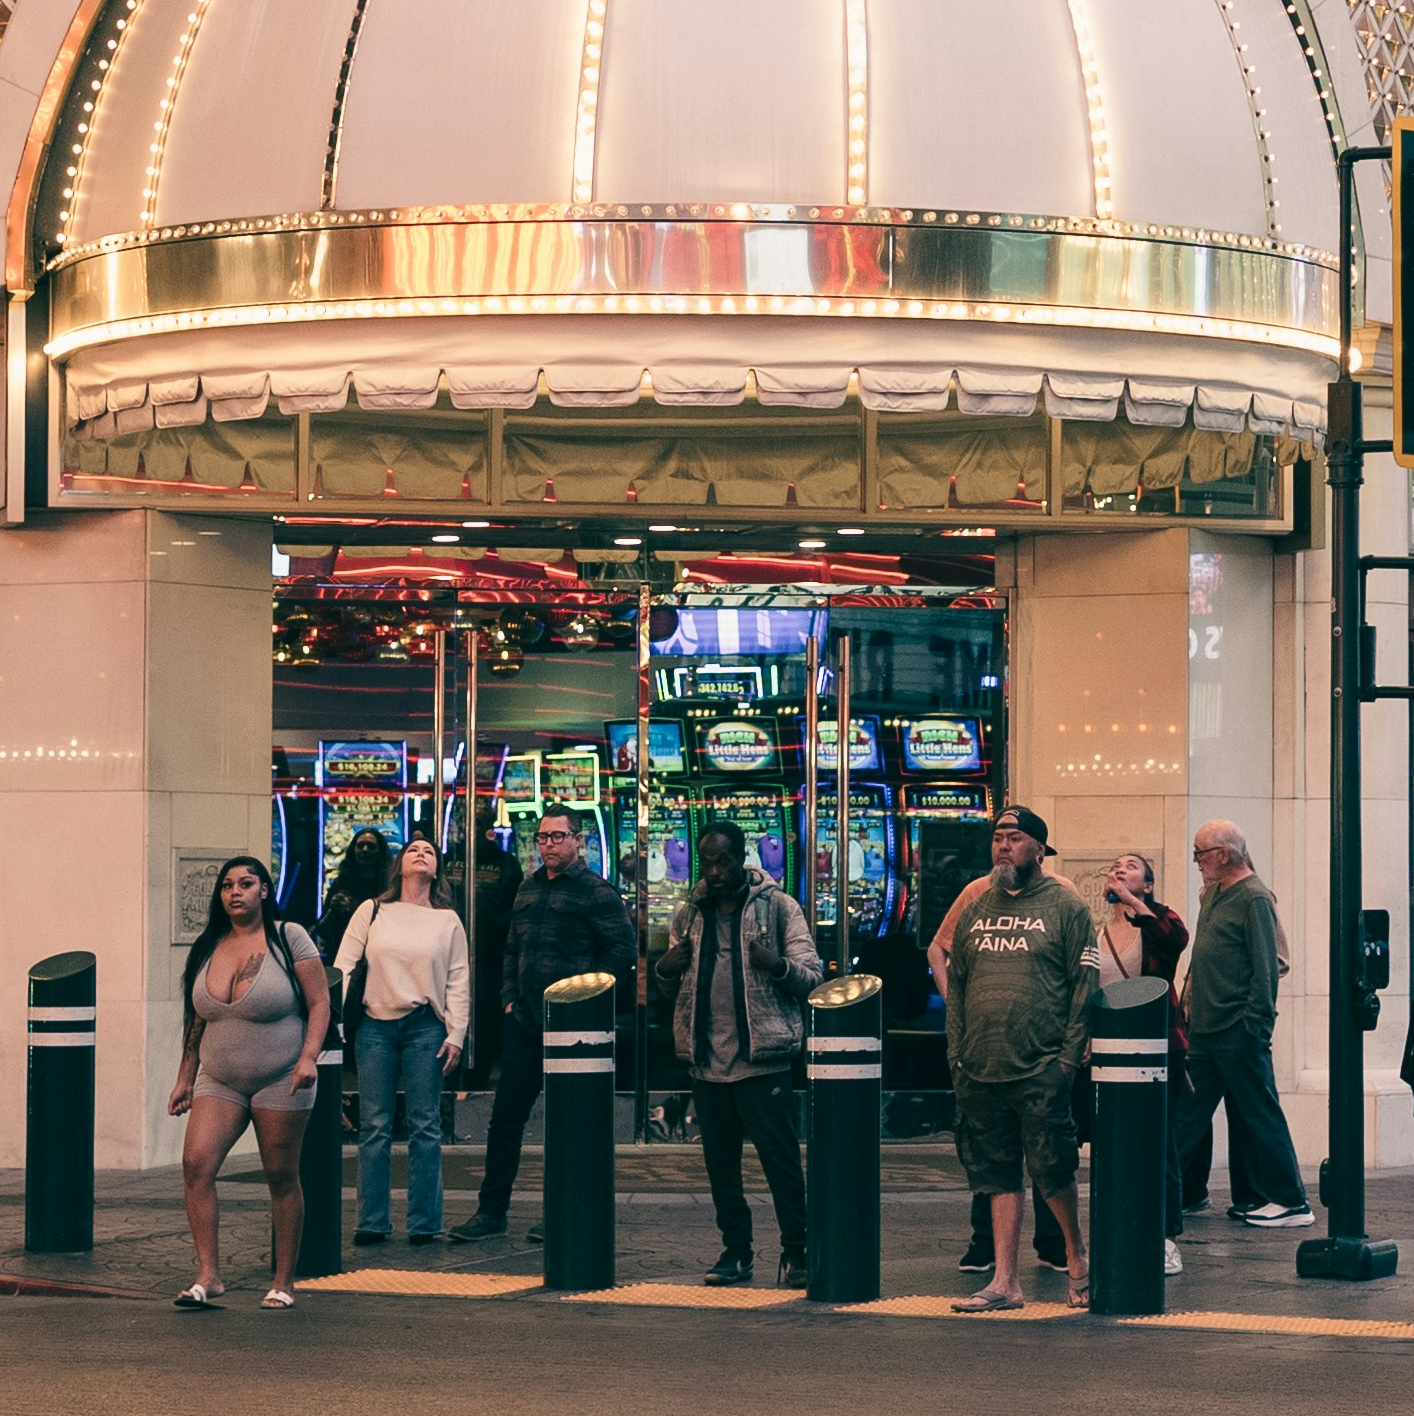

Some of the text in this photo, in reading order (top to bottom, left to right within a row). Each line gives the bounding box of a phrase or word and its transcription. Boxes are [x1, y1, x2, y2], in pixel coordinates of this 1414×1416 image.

[708, 744, 768, 755] Little Hens
[910, 743, 972, 754] Little Hens
[970, 916, 1046, 933] ALOHA
